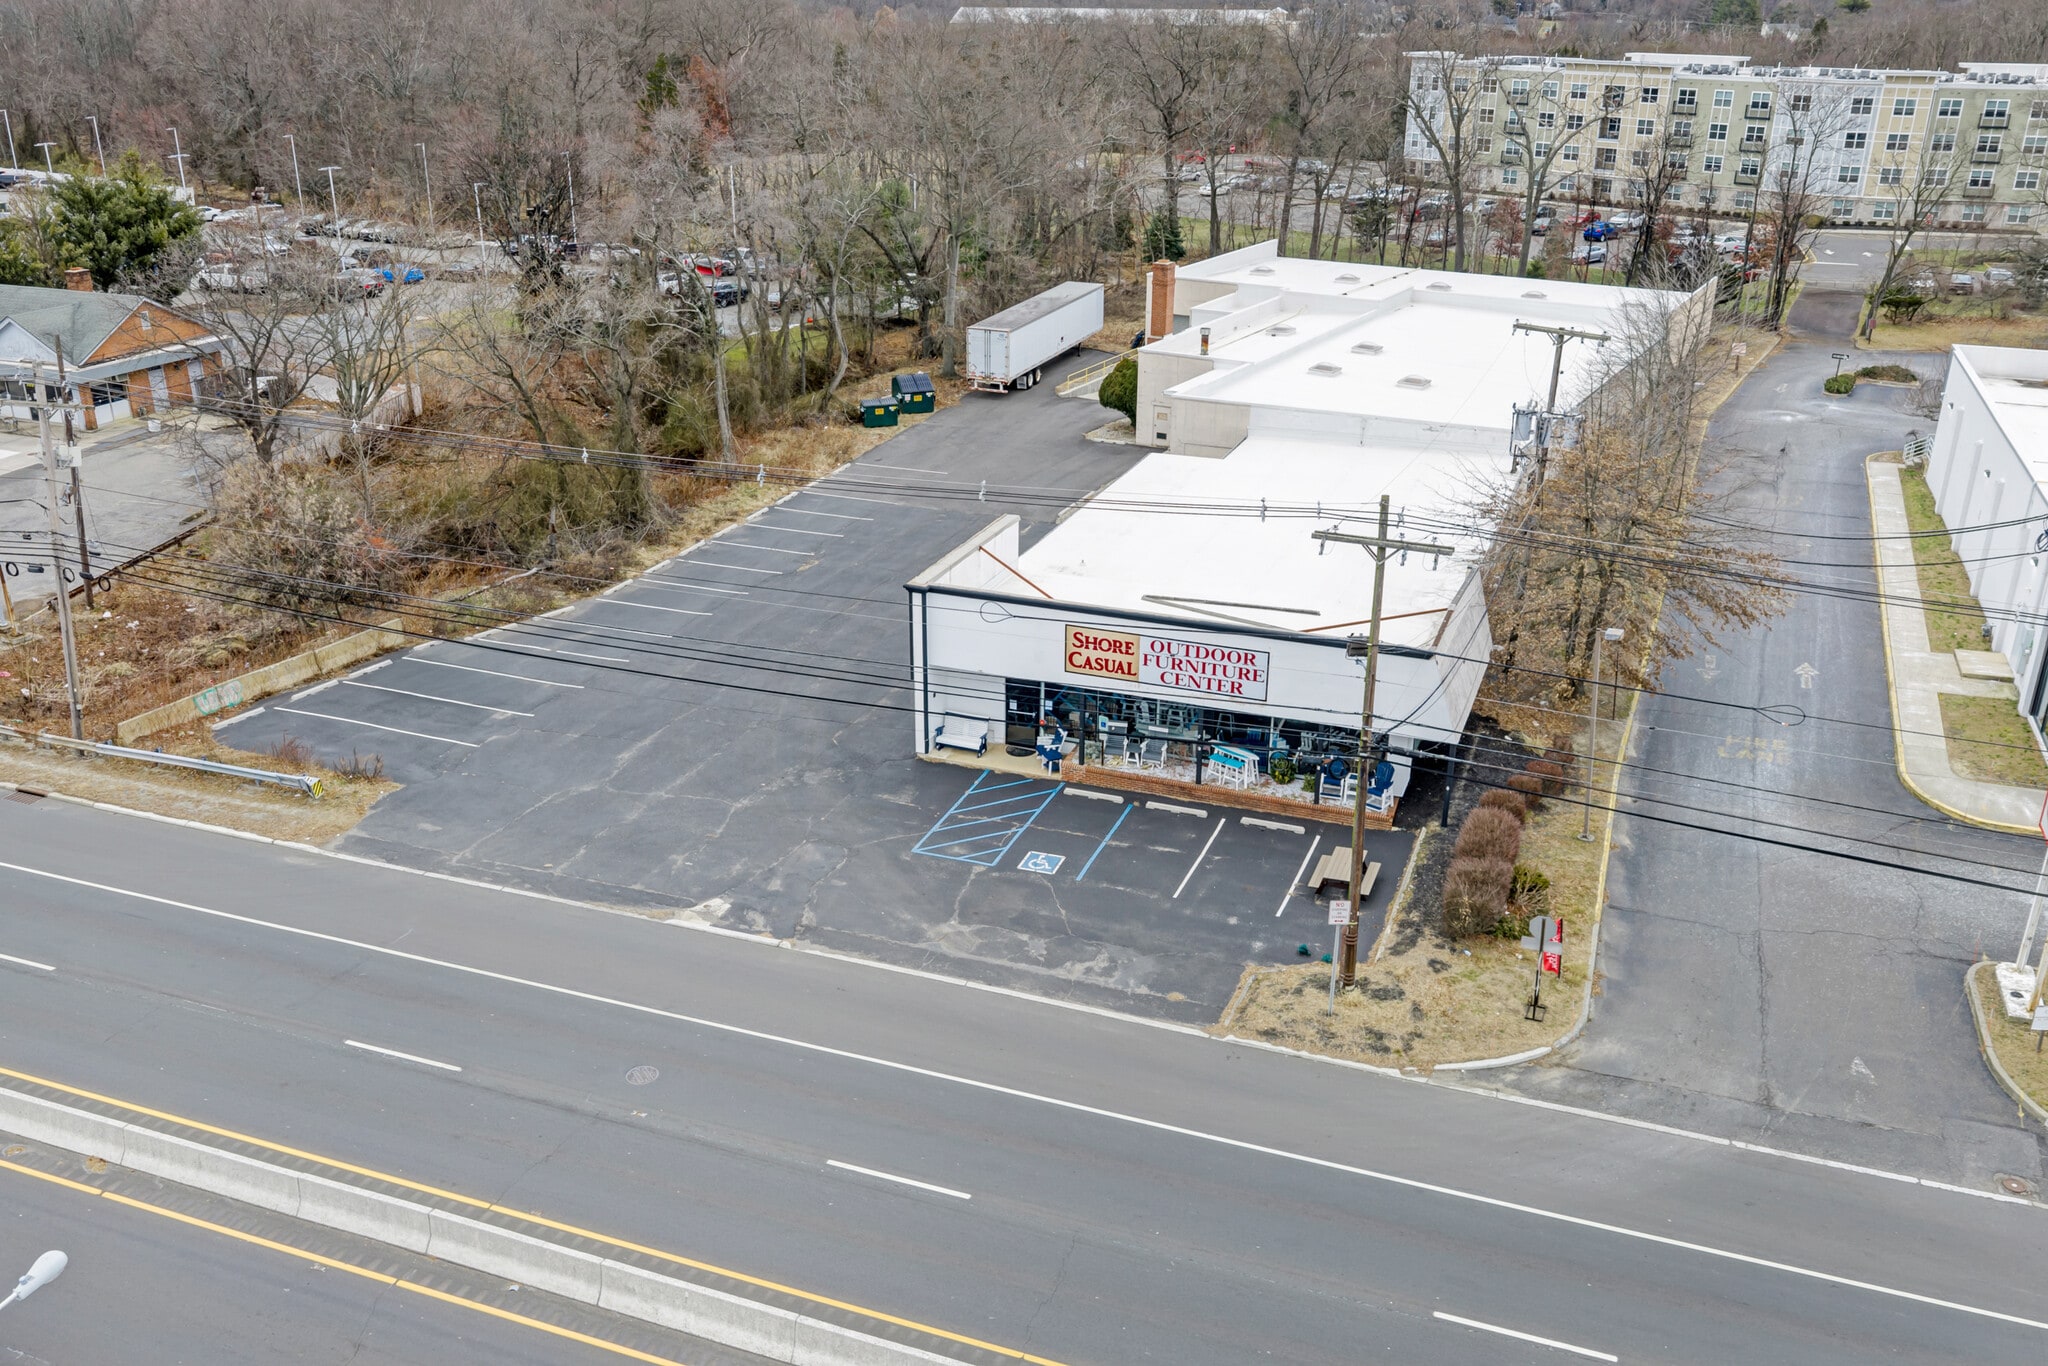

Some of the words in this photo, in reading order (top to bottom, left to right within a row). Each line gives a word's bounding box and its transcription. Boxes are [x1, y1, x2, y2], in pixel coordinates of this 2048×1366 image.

[1072, 631, 1135, 656] SHORE
[1150, 639, 1257, 667] OUTDOOR
[1068, 651, 1137, 676] CASUAL
[1142, 653, 1265, 683] FURNITURE
[1160, 671, 1244, 695] CENTER
